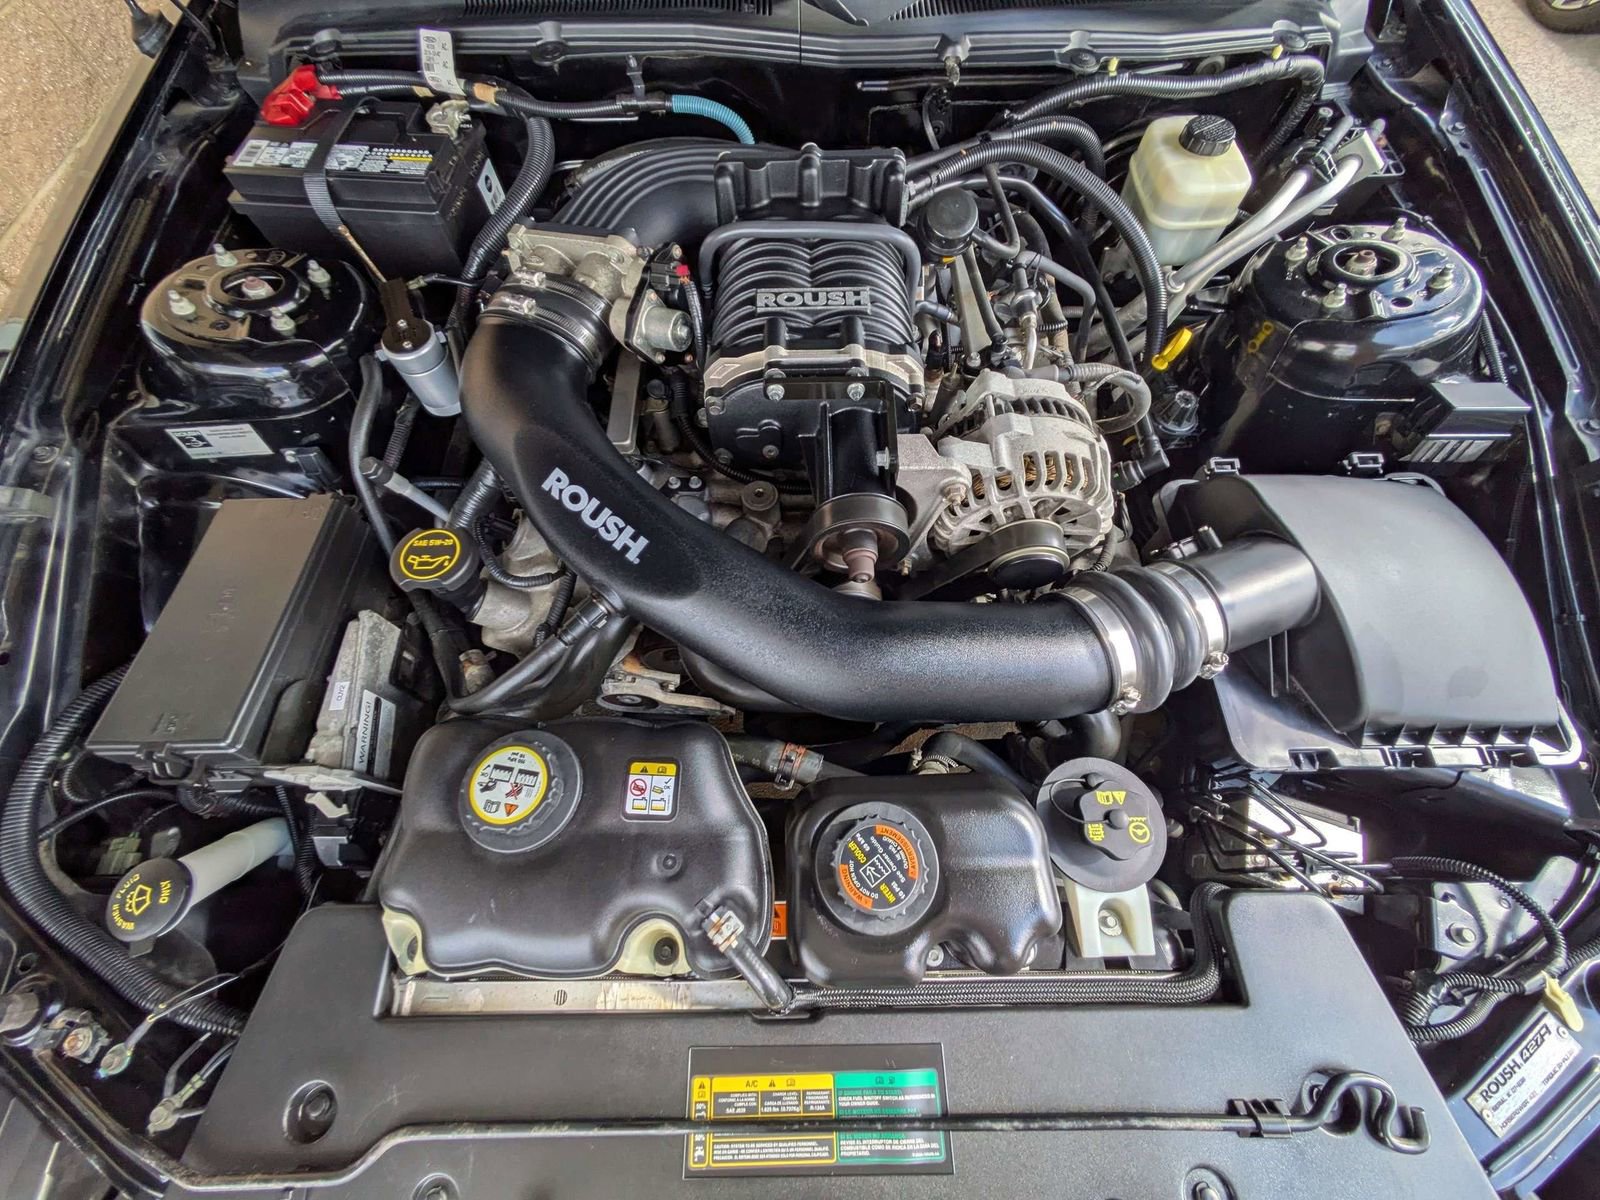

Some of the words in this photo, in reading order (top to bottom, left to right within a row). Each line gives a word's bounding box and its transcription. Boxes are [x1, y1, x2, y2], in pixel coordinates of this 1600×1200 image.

[756, 291, 869, 307] ROUSH
[541, 467, 649, 562] ROUSH
[359, 701, 372, 764] WARNING!
[848, 840, 867, 864] COOLER
[870, 836, 884, 853] Guide
[880, 827, 917, 870] AVERTISSEMENT
[882, 852, 897, 872] Owner
[116, 873, 140, 899] FLUID
[841, 869, 864, 901] WARNING
[850, 871, 861, 888] OPEN
[896, 870, 906, 883] See
[159, 880, 171, 904] ONLY
[860, 886, 870, 896] NOT
[880, 882, 896, 903] INTER
[112, 903, 135, 930] WASHER
[1480, 1058, 1521, 1103] ROUSH
[1519, 1023, 1552, 1064] 427R
[745, 1080, 759, 1088] A/C
